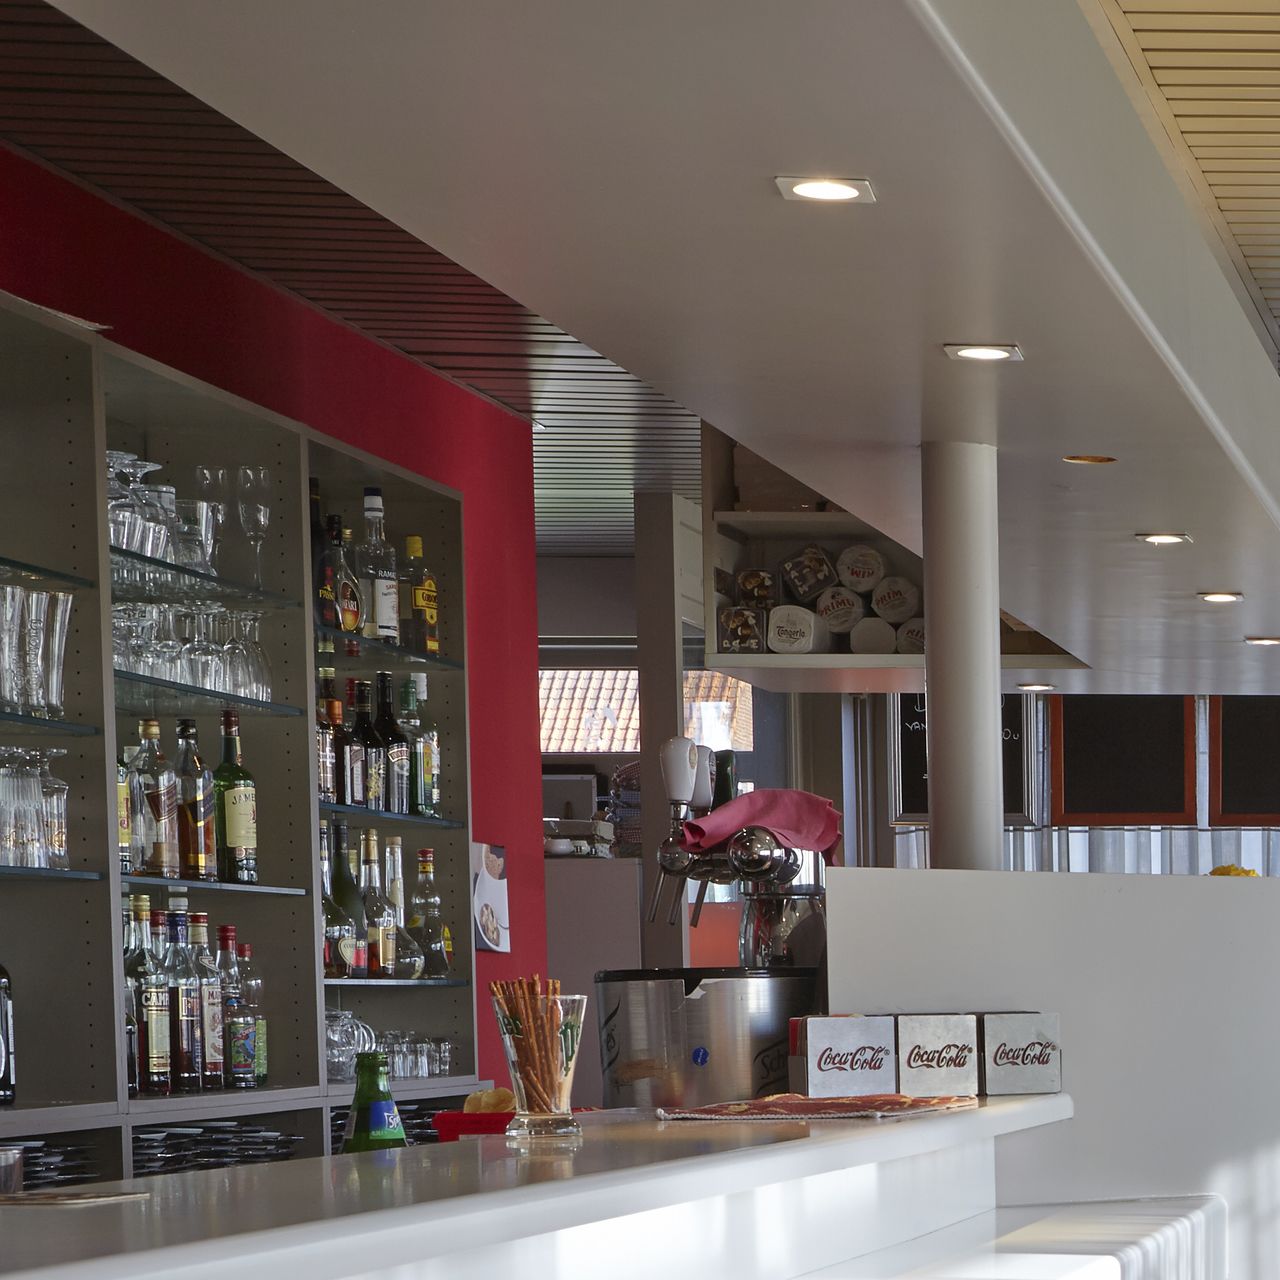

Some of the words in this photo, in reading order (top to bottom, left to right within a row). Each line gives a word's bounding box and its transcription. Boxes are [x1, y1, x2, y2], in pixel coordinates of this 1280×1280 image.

[817, 1045, 885, 1072] Coca-Cola
[906, 1043, 970, 1069] Coca-Cola
[993, 1041, 1053, 1067] Coca-Cola
